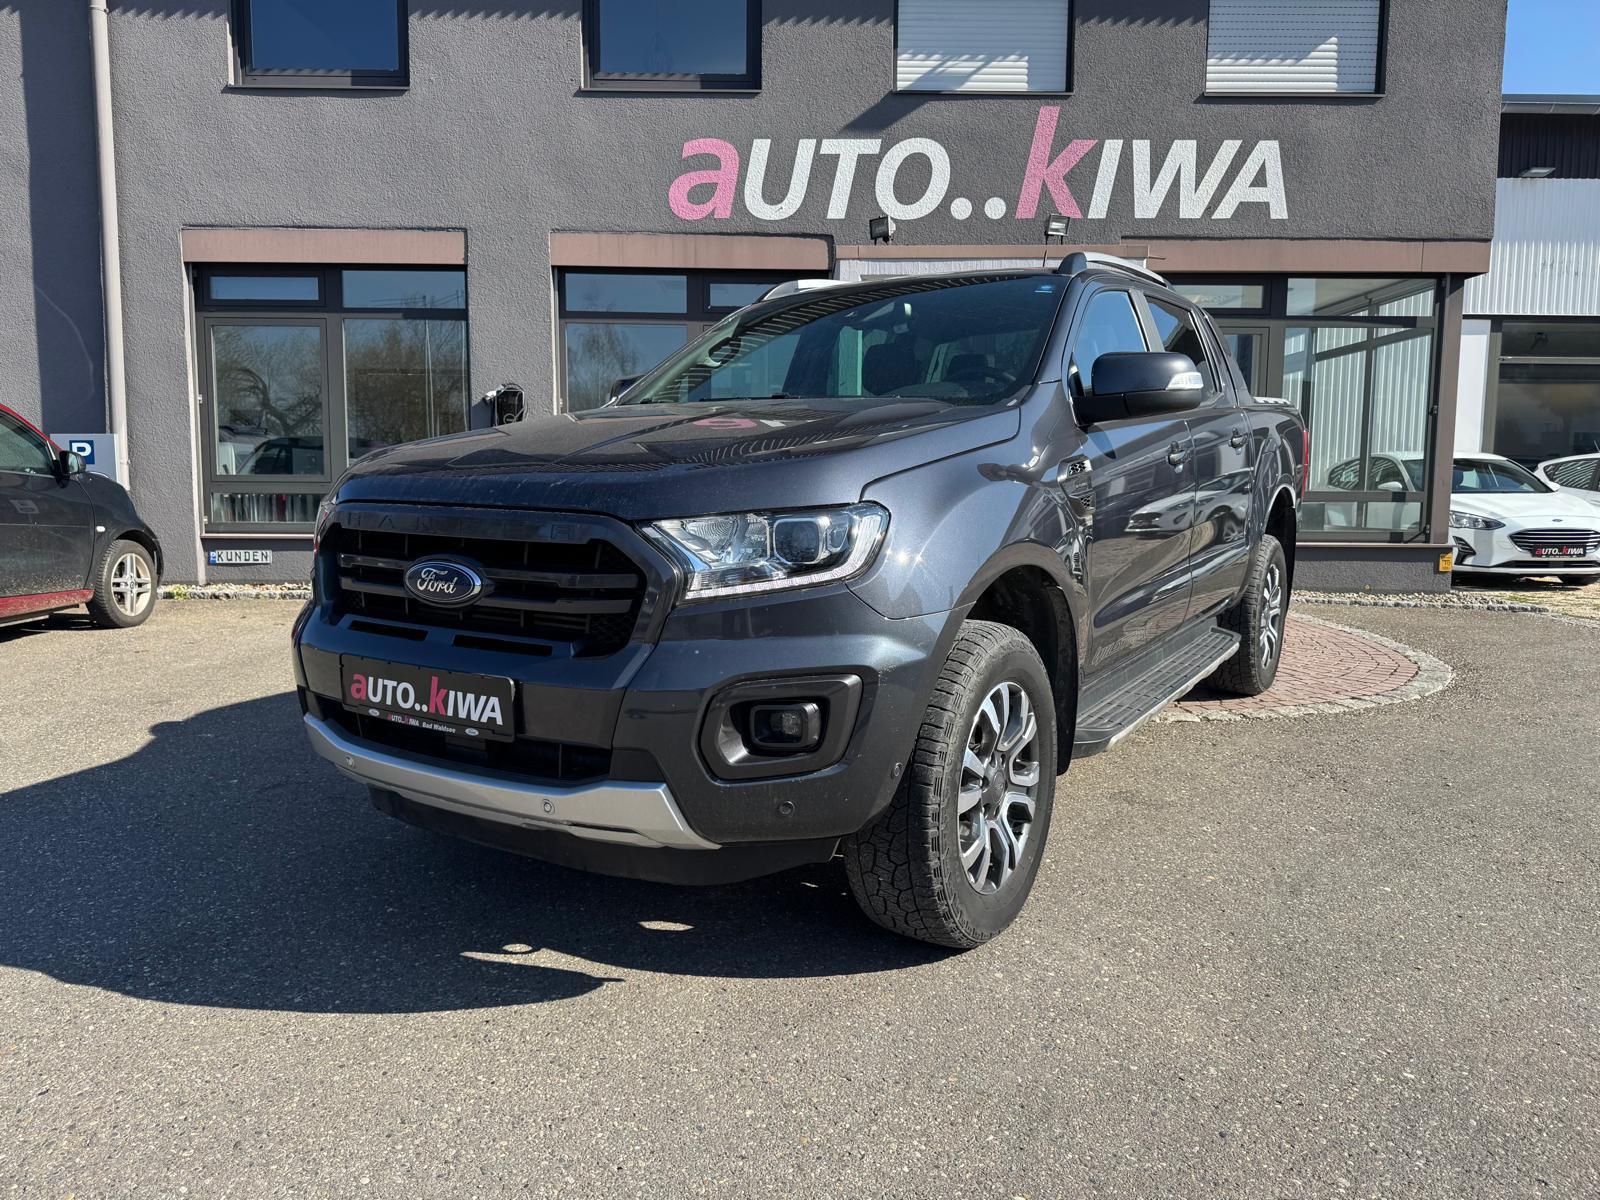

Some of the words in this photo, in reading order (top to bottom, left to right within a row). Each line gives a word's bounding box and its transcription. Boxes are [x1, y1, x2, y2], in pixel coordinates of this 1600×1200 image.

[217, 551, 268, 562] KUNDEN
[416, 567, 457, 594] Ford
[422, 721, 433, 729] Bad
[433, 723, 456, 734] Waldsee
